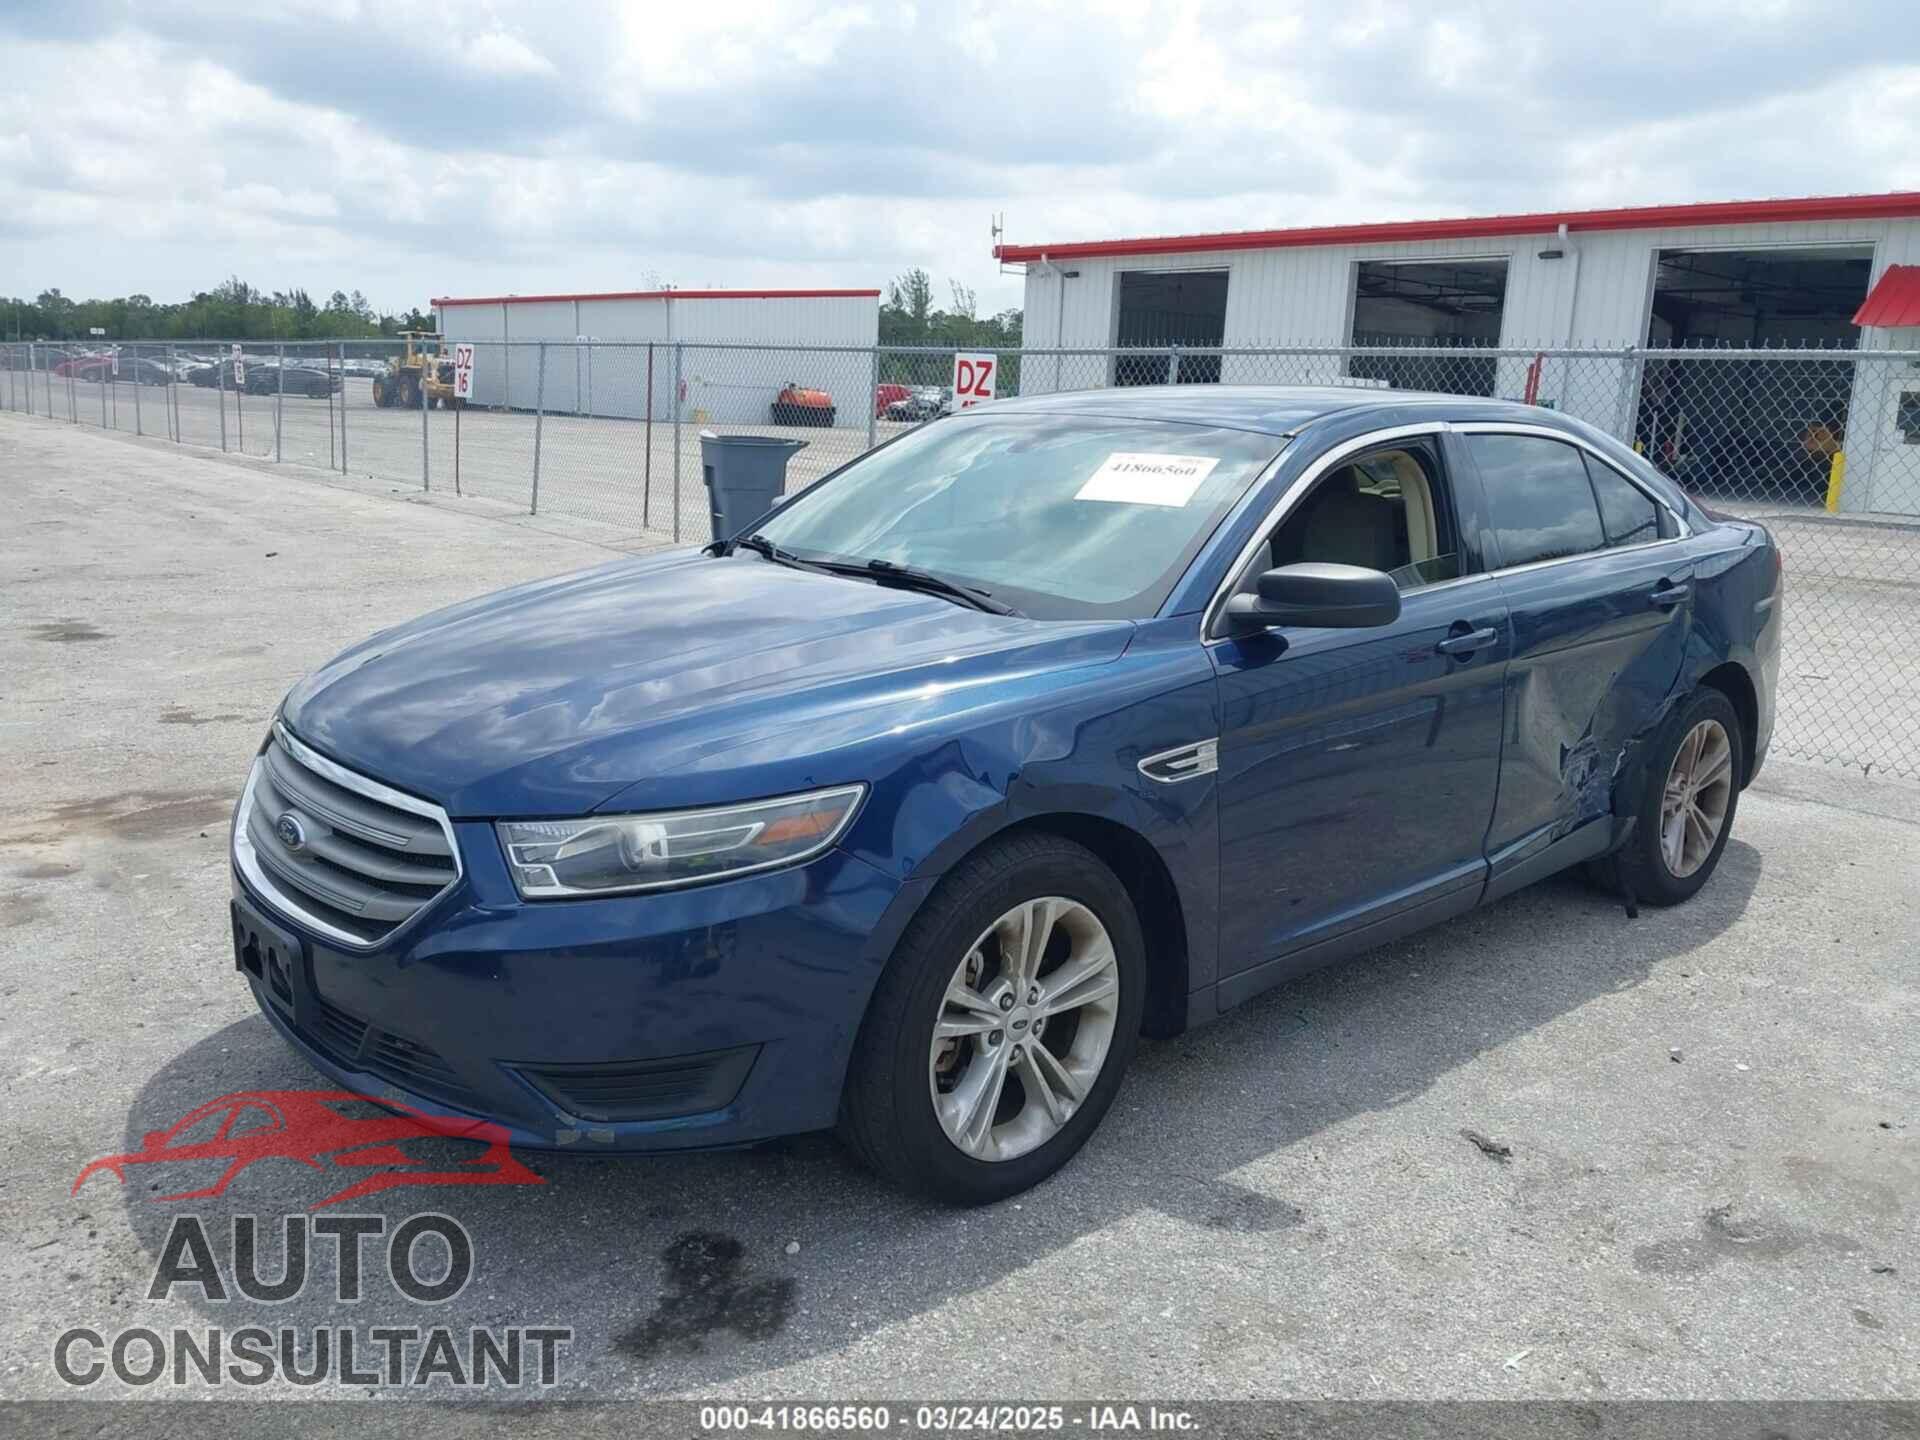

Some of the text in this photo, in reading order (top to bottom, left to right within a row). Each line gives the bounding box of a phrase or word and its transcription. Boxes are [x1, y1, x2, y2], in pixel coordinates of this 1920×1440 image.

[457, 348, 472, 369] DZ
[458, 372, 468, 393] 16
[957, 360, 993, 397] DZ
[1111, 463, 1197, 476] 41866560
